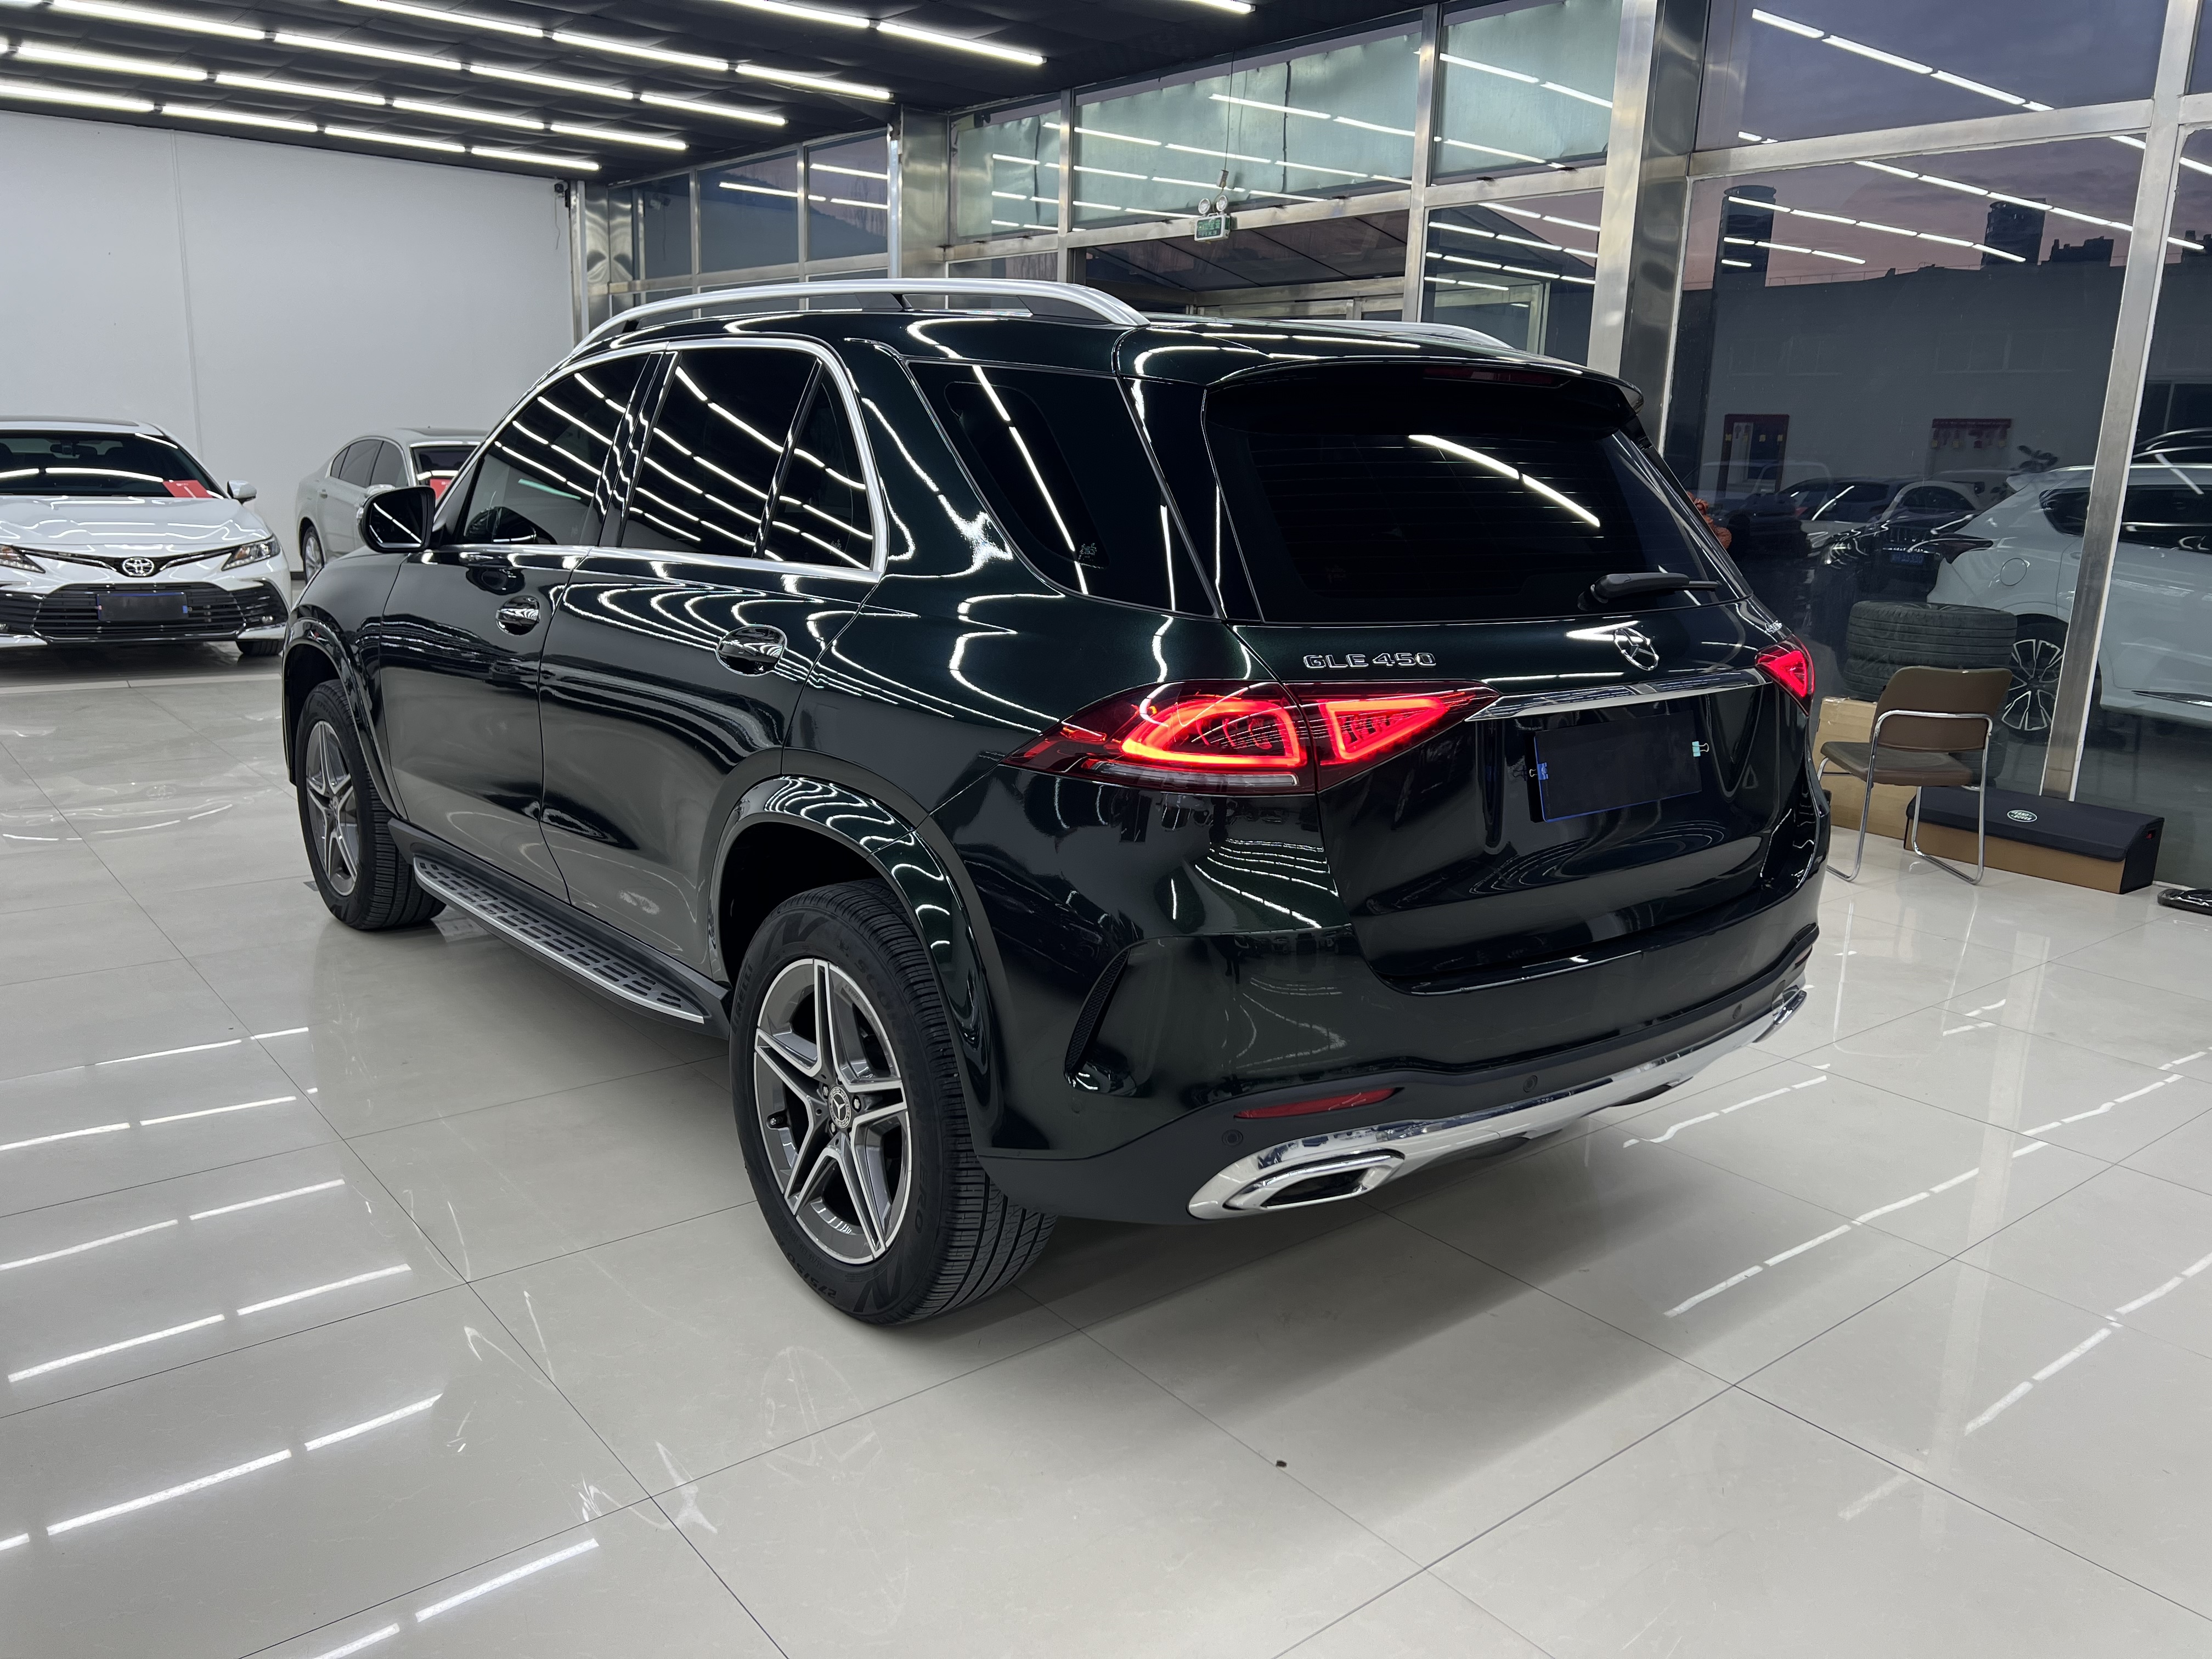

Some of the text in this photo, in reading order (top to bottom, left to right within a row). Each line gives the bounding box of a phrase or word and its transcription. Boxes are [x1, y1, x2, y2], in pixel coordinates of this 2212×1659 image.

[1303, 652, 1436, 669] GLE 450
[787, 1252, 837, 1299] 275/50
